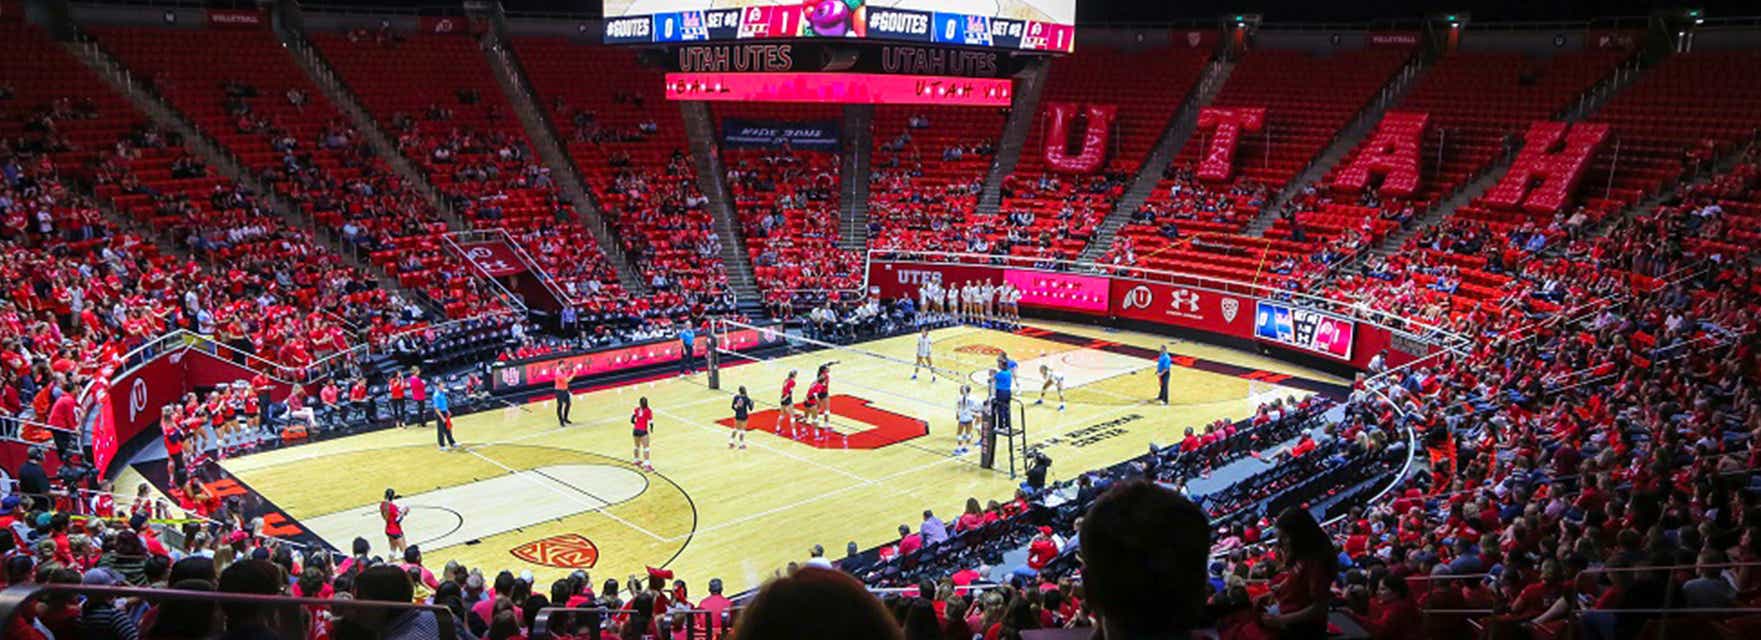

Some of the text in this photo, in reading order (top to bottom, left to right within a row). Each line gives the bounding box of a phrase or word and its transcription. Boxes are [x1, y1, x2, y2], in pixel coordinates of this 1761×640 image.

[664, 18, 673, 38] 0
[707, 12, 724, 28] SET
[869, 12, 927, 34] #GOUTES
[945, 19, 955, 40] 0
[992, 21, 1008, 36] SET
[679, 44, 793, 72] UTAH UTES
[881, 46, 997, 75] UTAH UTES
